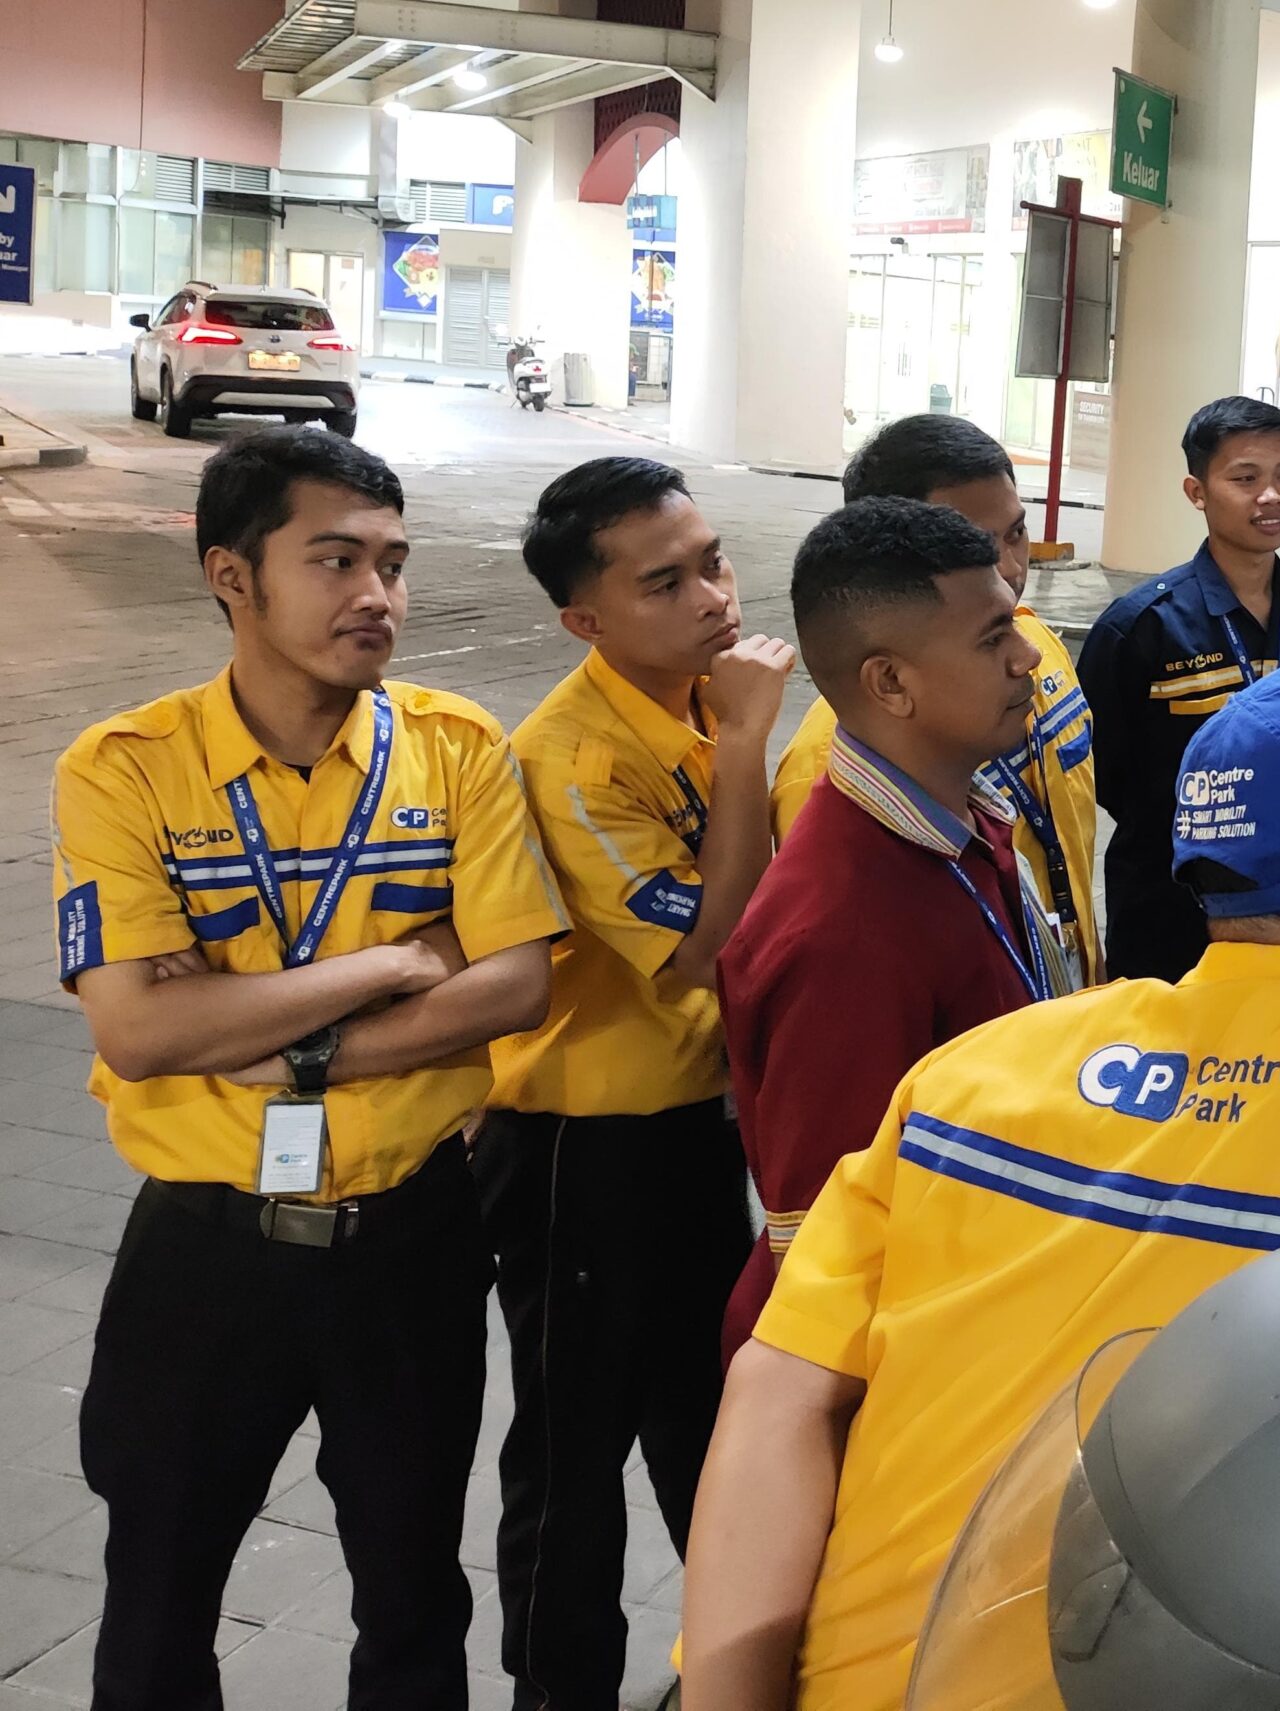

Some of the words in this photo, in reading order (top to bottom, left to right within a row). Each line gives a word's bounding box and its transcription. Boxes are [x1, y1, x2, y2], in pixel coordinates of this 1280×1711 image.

[1123, 151, 1159, 191] Keluar
[1165, 652, 1224, 672] BEYOND
[360, 750, 386, 815] CENTREPARK
[1180, 770, 1210, 805] CP
[1209, 767, 1255, 787] Centre
[1210, 785, 1236, 805] Park
[391, 806, 429, 828] CP
[1214, 804, 1247, 822] MOBILITY
[1192, 826, 1218, 840] PARKING
[1218, 822, 1257, 839] SOLUTION
[255, 853, 283, 919] CENTREPARK
[313, 858, 349, 927] CENTREPARK
[1078, 1043, 1190, 1124] CP
[1175, 1092, 1247, 1124] Park
